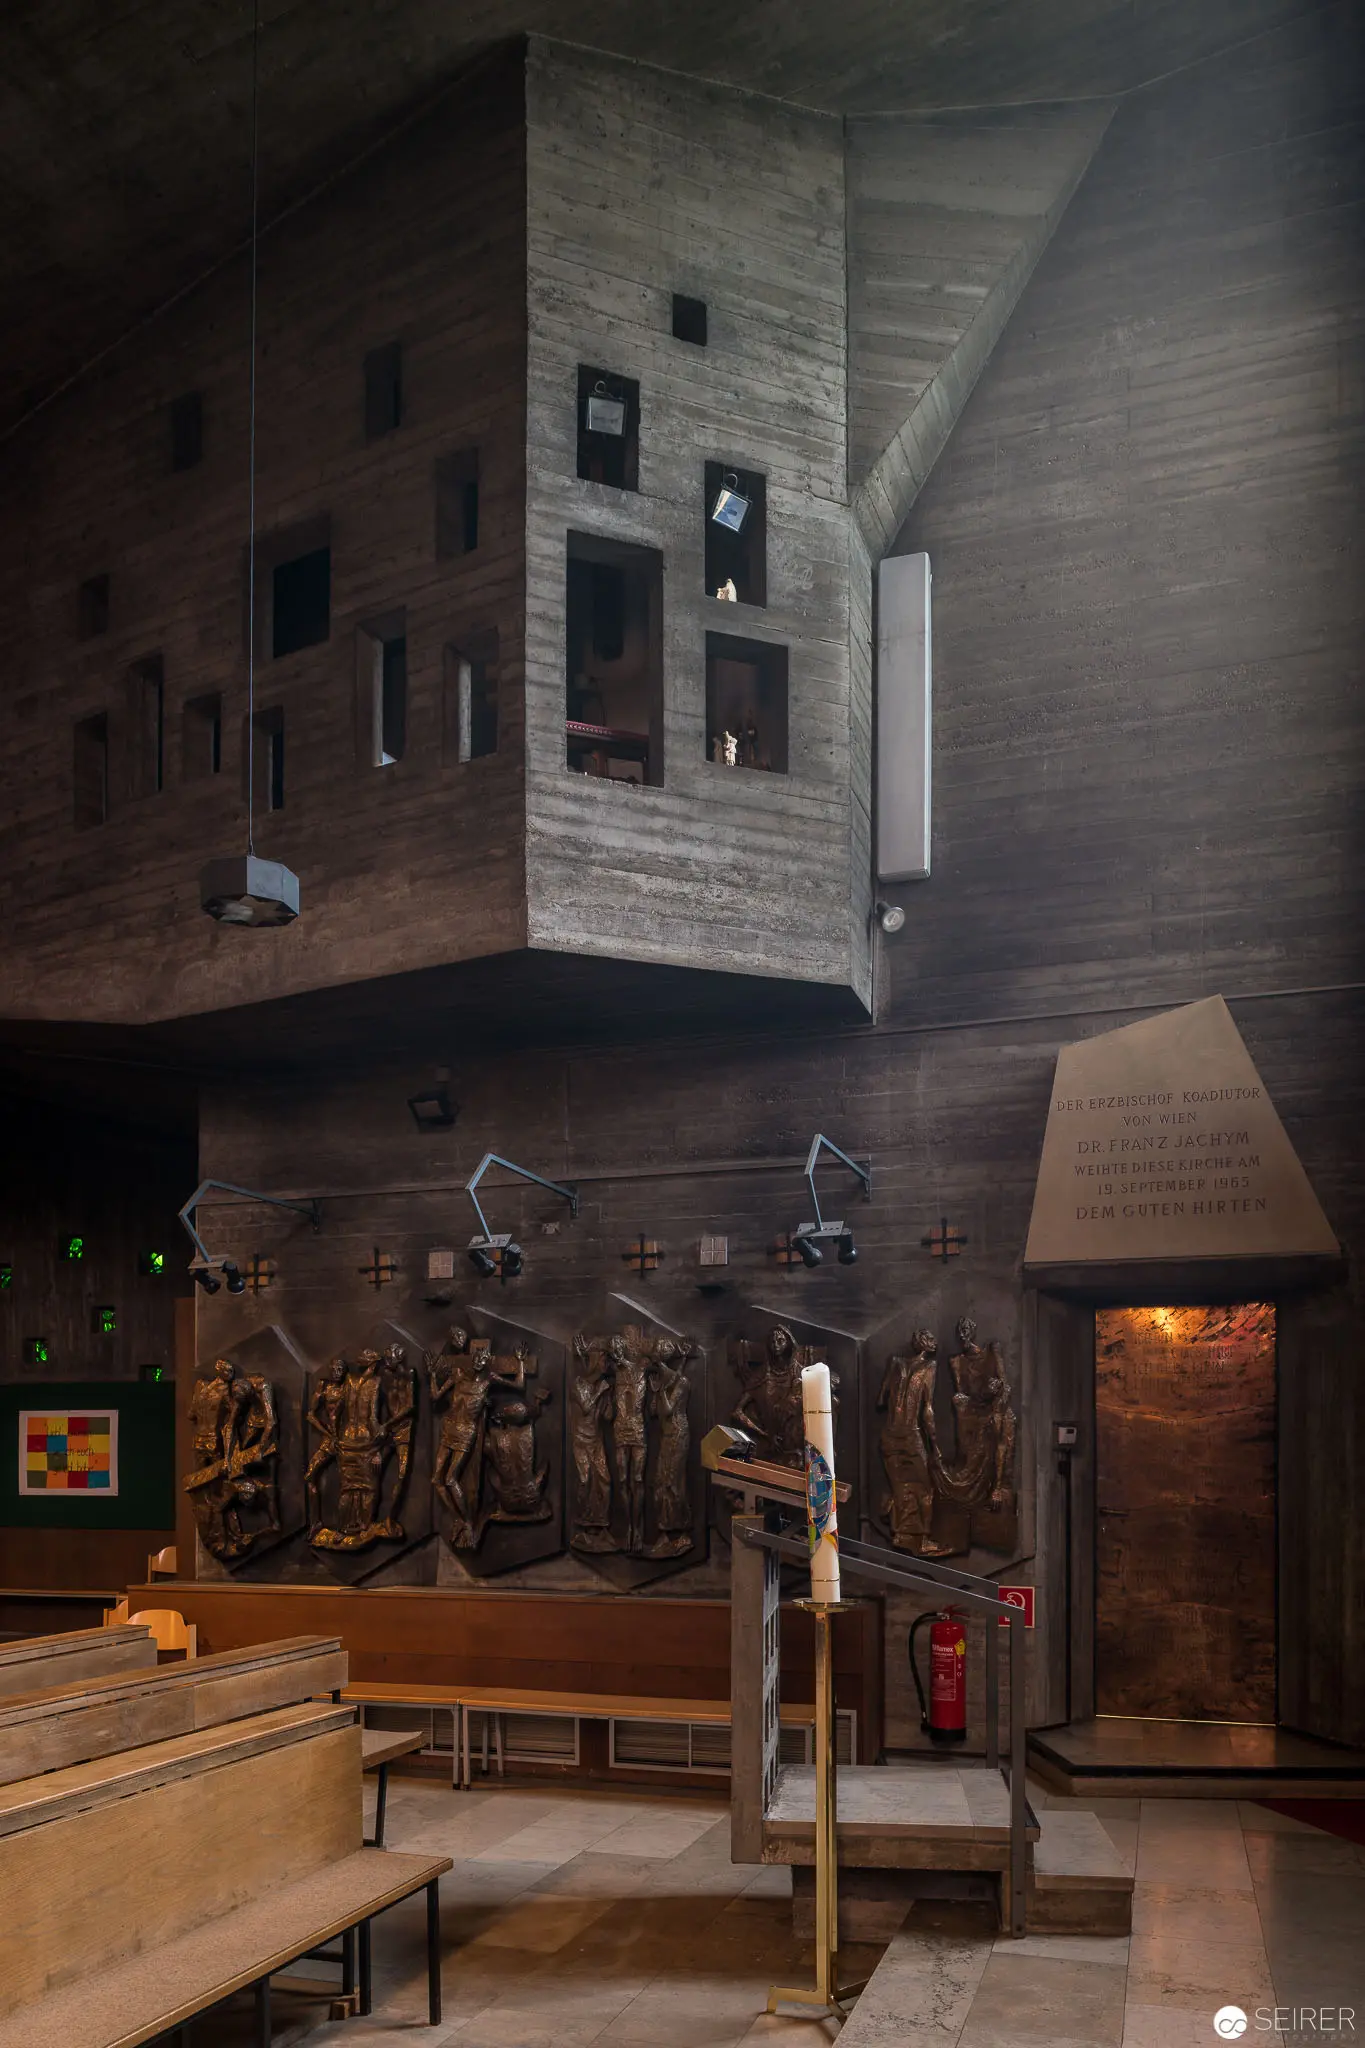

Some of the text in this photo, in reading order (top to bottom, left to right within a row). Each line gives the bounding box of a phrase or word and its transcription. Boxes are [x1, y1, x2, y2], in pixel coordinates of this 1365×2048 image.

[1057, 1101, 1084, 1112] DER
[1089, 1093, 1174, 1110] ERZBISCHOF
[1122, 1112, 1197, 1127] VON WIEN
[1077, 1131, 1250, 1154] DR. FRANZ JACHYM
[1074, 1155, 1260, 1177] WEIHTE DIESE KIRCHE AM
[1098, 1176, 1250, 1195] 19. SEPTEMBER 1965
[1076, 1198, 1267, 1220] DEM GUTEN HIRTEN
